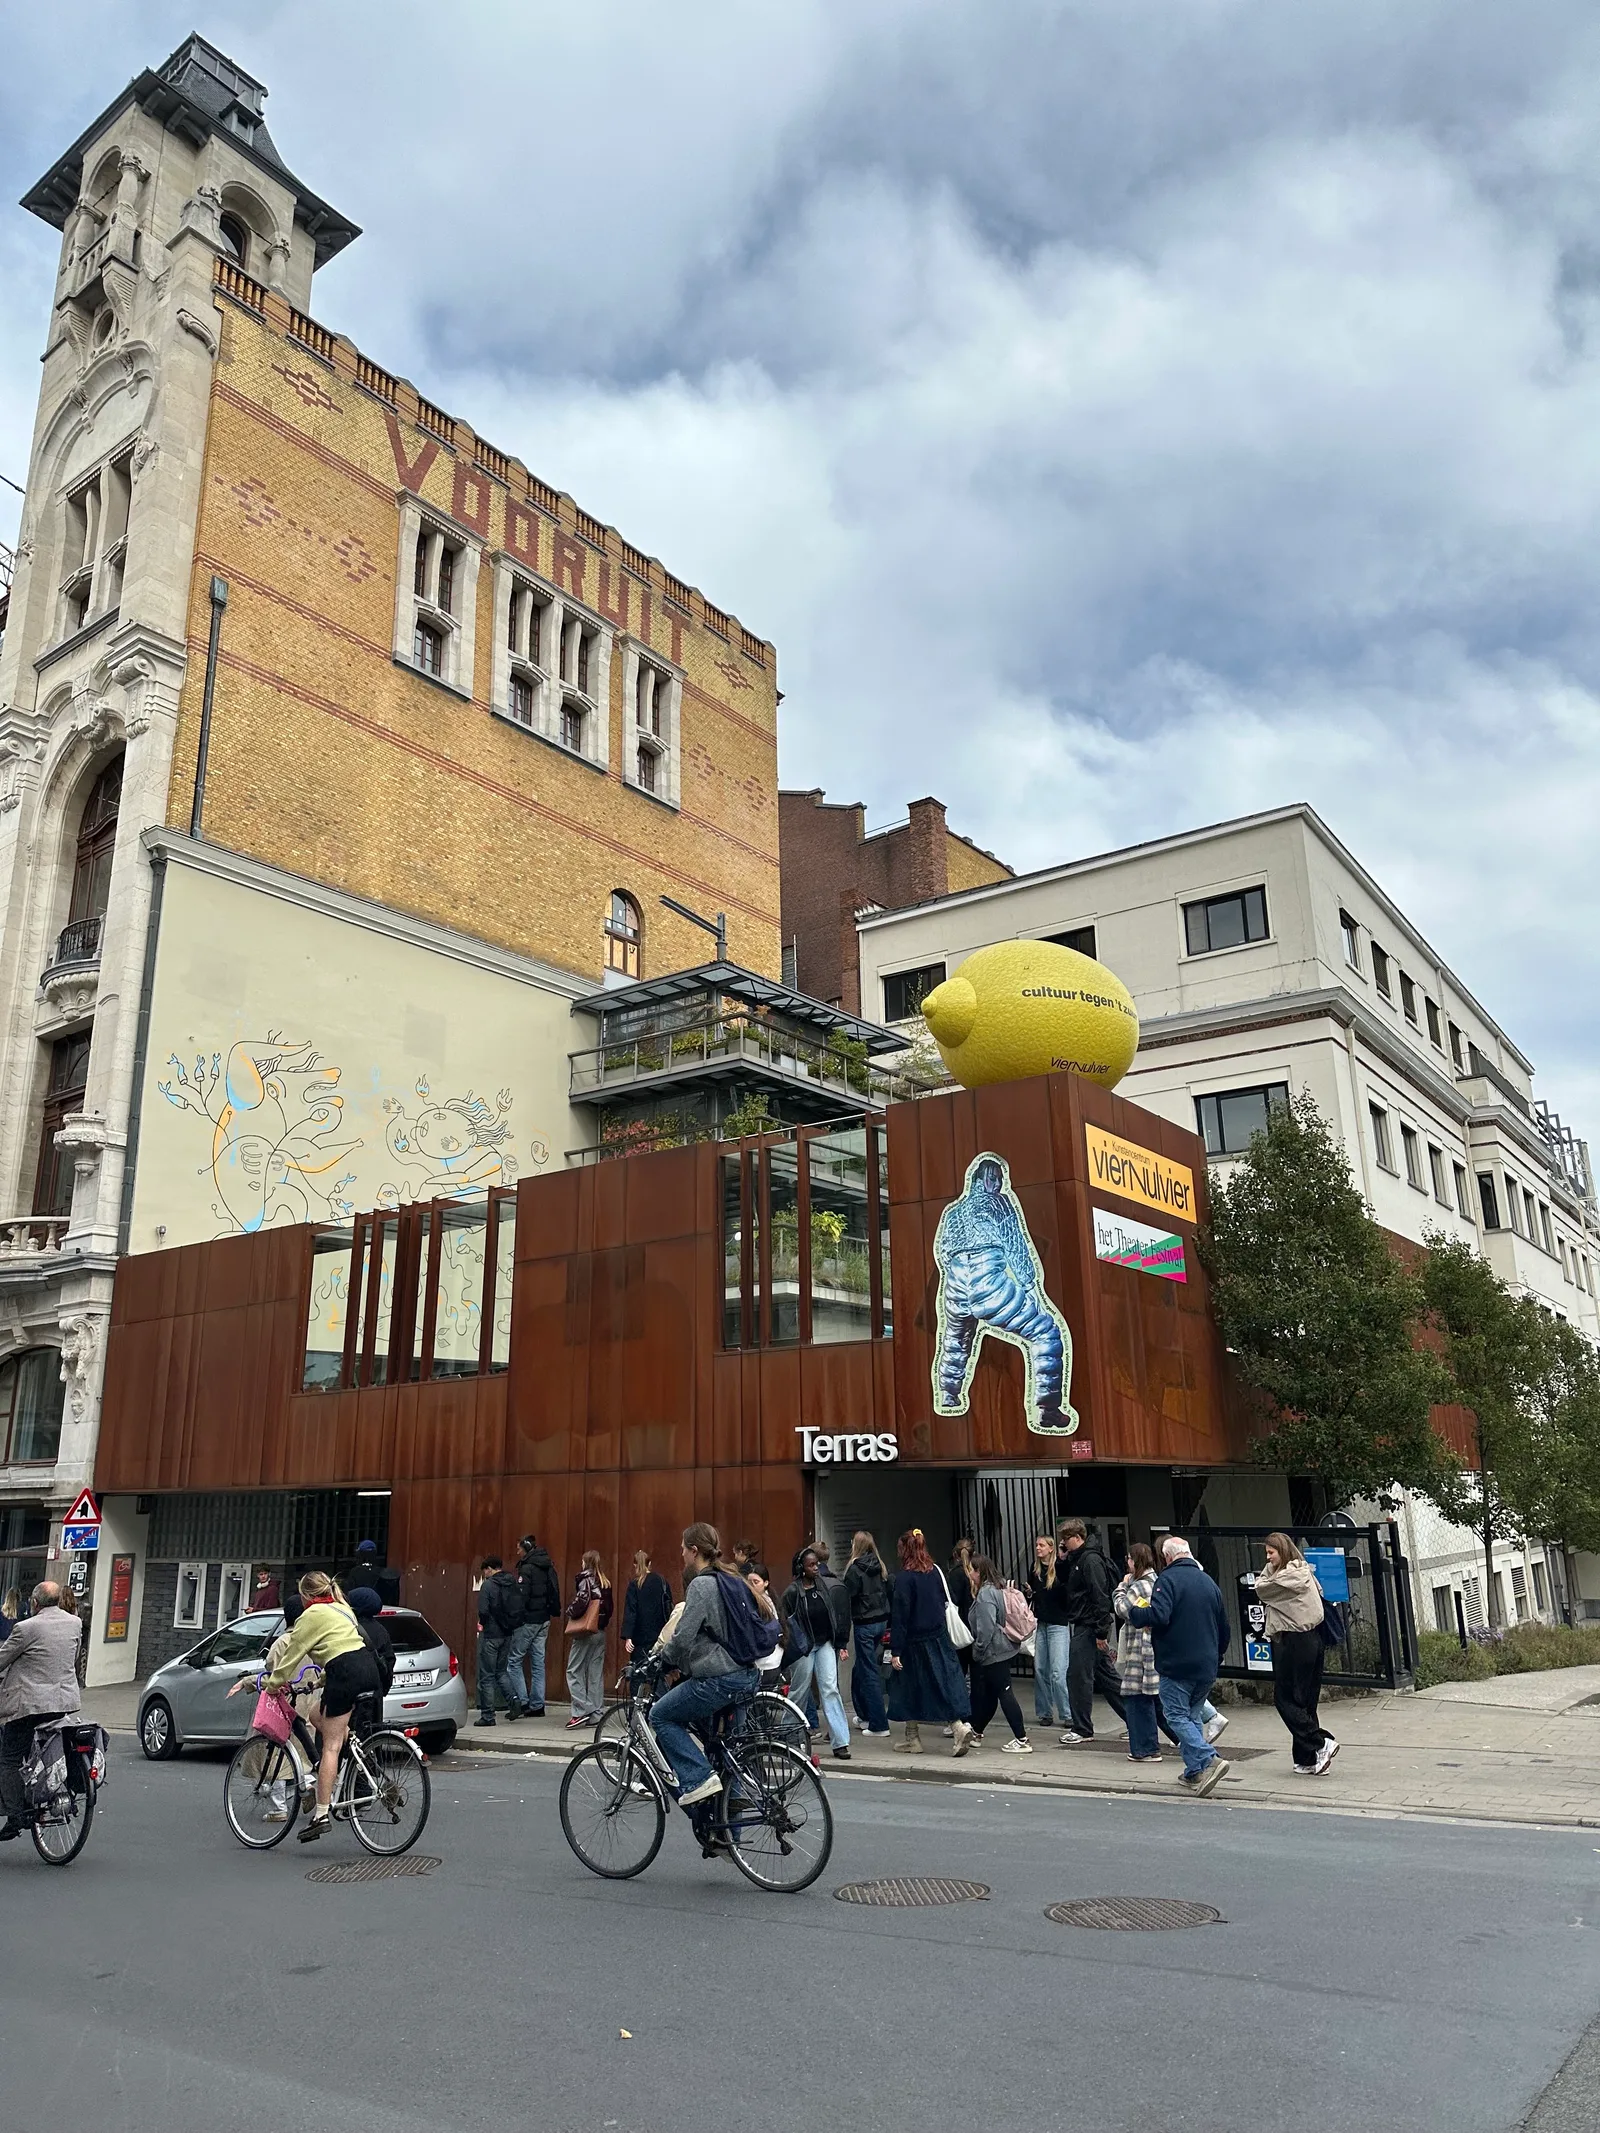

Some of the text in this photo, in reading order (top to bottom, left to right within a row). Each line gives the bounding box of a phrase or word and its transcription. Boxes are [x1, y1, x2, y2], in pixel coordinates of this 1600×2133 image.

[382, 407, 691, 665] VOORUIT
[1021, 986, 1077, 1000] cultuur
[1080, 990, 1114, 1008] tegen
[1111, 1140, 1151, 1166] Kunstencentrum
[1097, 1221, 1183, 1268] het Theater Festival
[794, 1426, 899, 1463] Terras
[1254, 1644, 1270, 1660] 25
